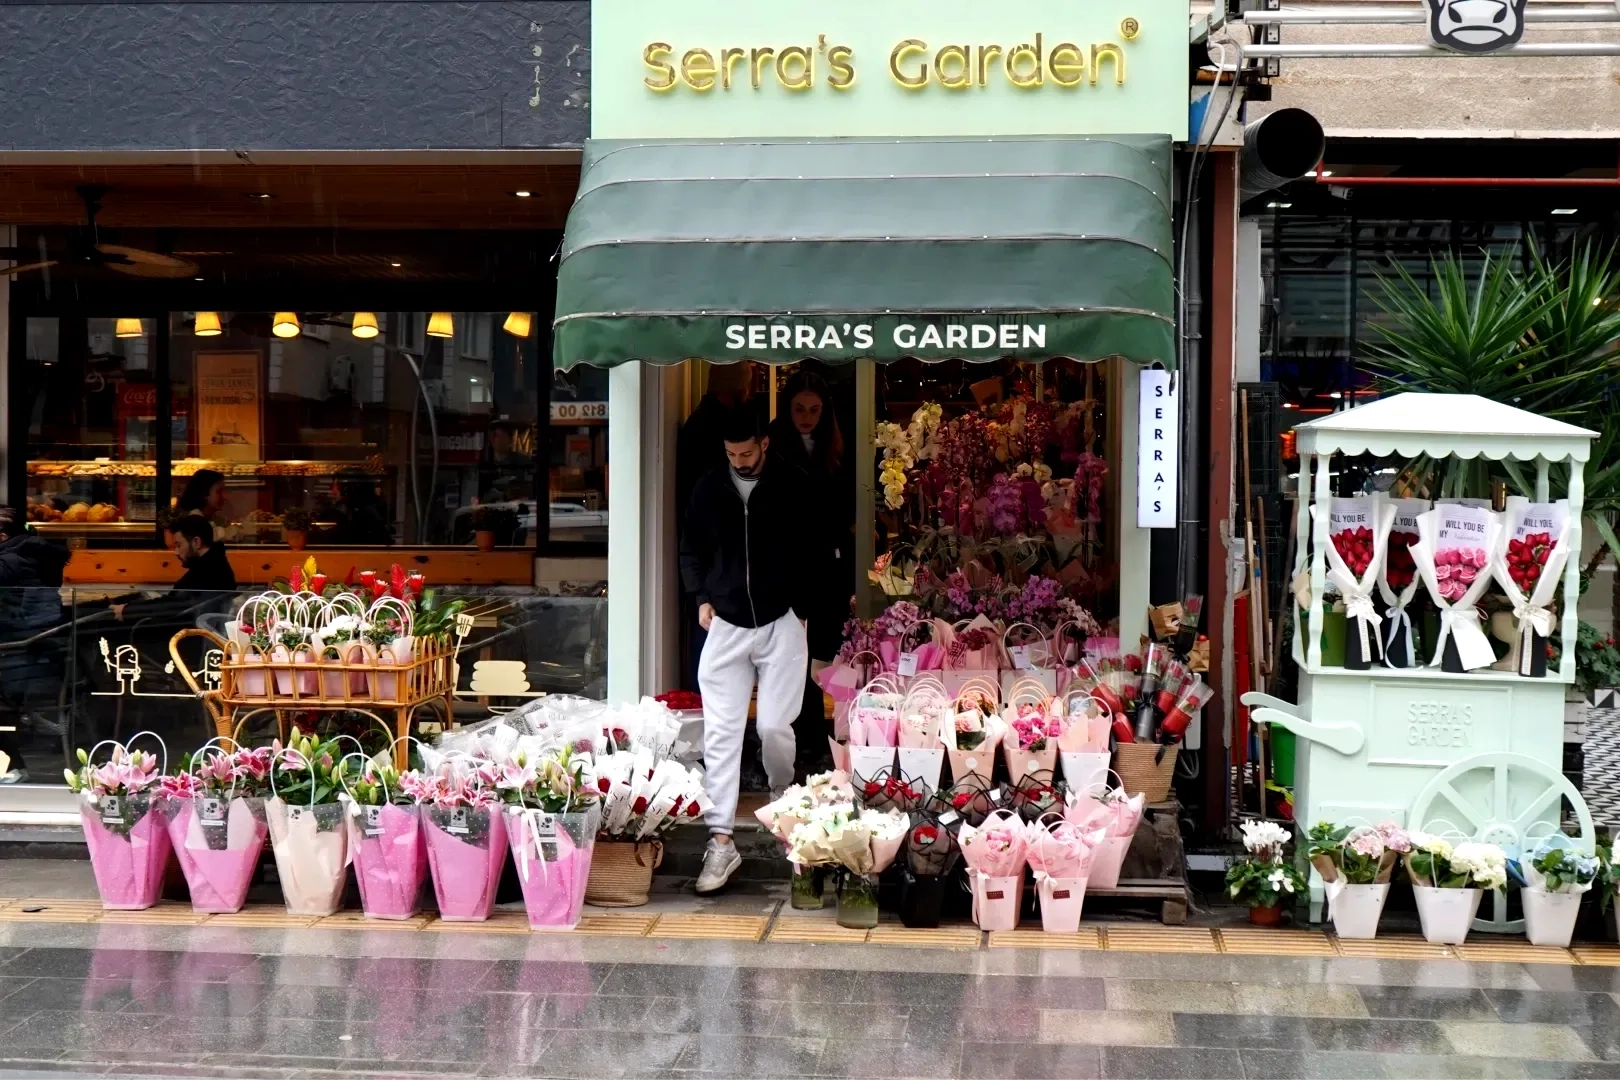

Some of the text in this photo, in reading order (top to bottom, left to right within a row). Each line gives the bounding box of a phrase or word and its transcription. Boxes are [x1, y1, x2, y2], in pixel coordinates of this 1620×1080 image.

[643, 34, 857, 90] Serra's
[889, 32, 1125, 88] Garden
[725, 322, 1046, 349] SERRA'S GARDEN
[1342, 514, 1356, 523] YOU
[1357, 513, 1366, 522] BE
[1523, 517, 1538, 528] WILL
[1445, 519, 1485, 533] WILL YOU BE
[1516, 526, 1526, 536] MY
[1439, 529, 1449, 538] MY
